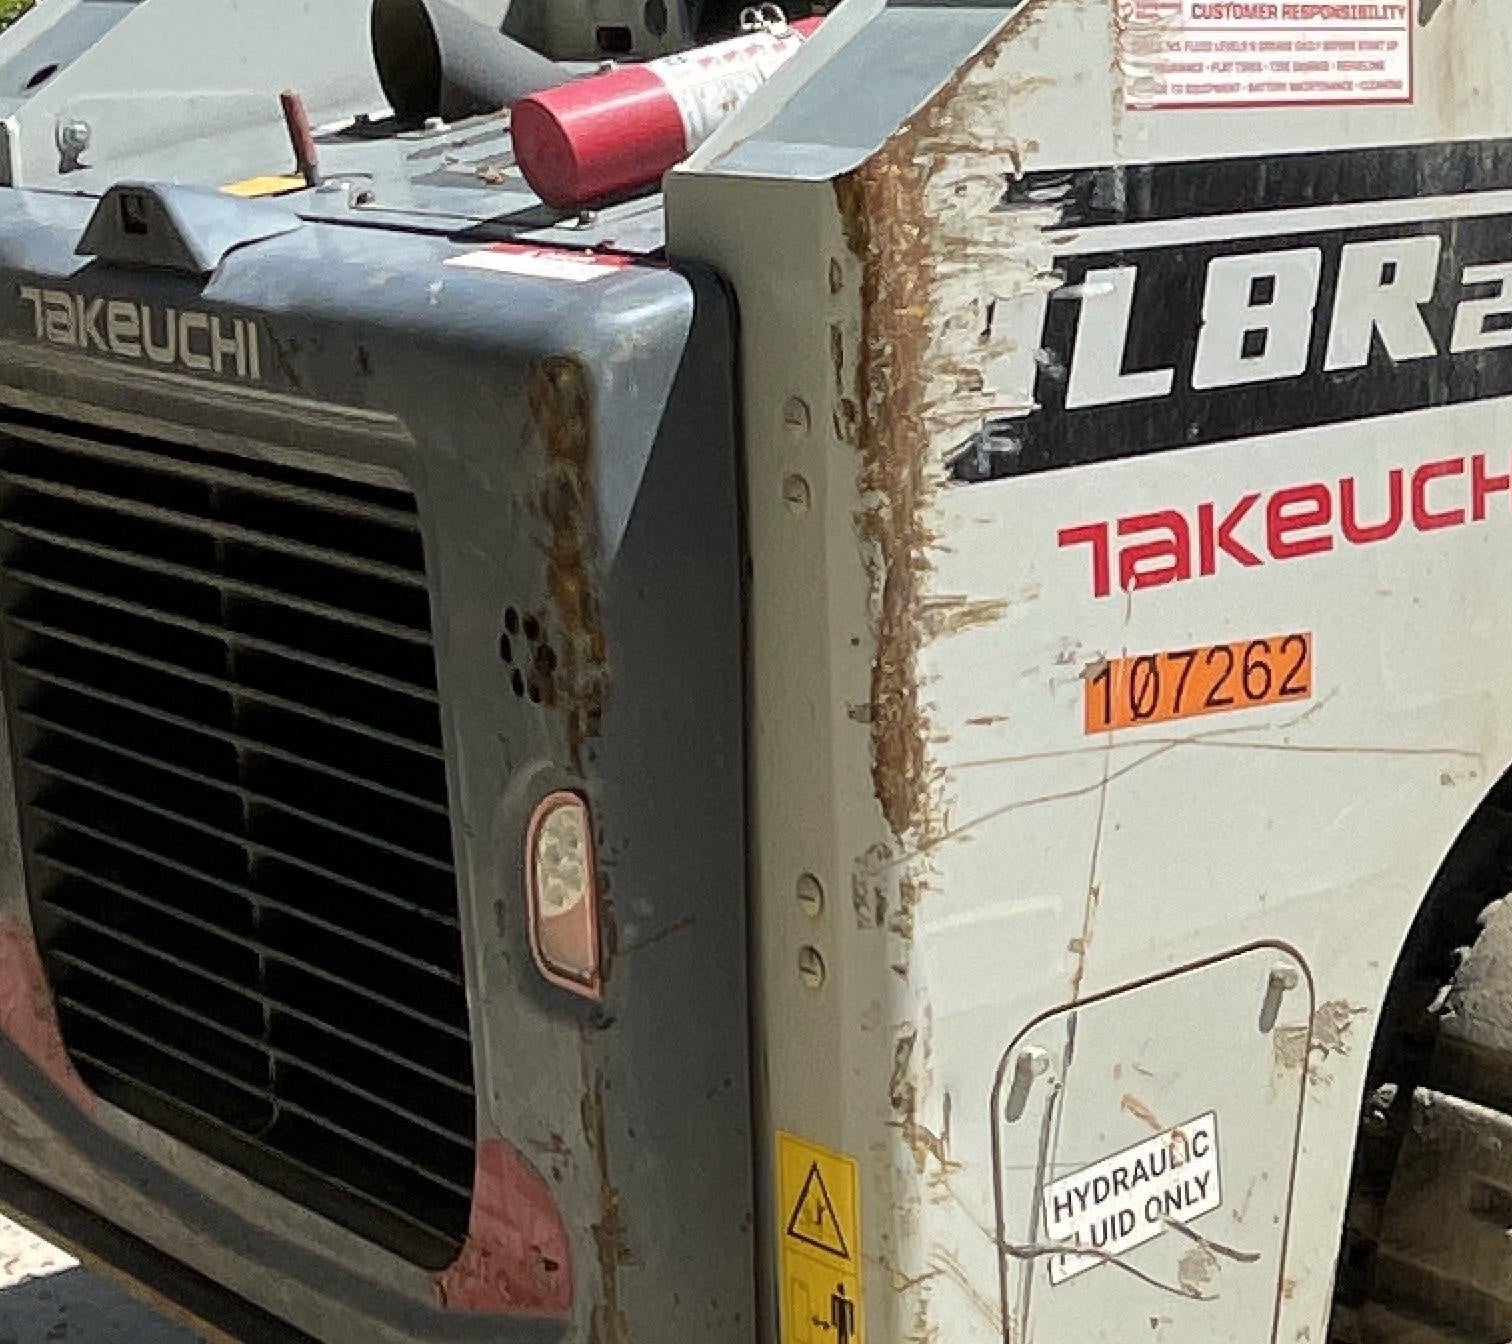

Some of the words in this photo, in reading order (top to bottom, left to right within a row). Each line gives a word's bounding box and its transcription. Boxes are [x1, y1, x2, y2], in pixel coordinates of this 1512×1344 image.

[1192, 2, 1278, 21] CUSTOMER
[1283, 3, 1406, 21] RESPONSIBILITY
[1090, 633, 1309, 727] 107262
[1053, 1129, 1211, 1224] HYDRAULIC
[1144, 1169, 1211, 1224] ONLY
